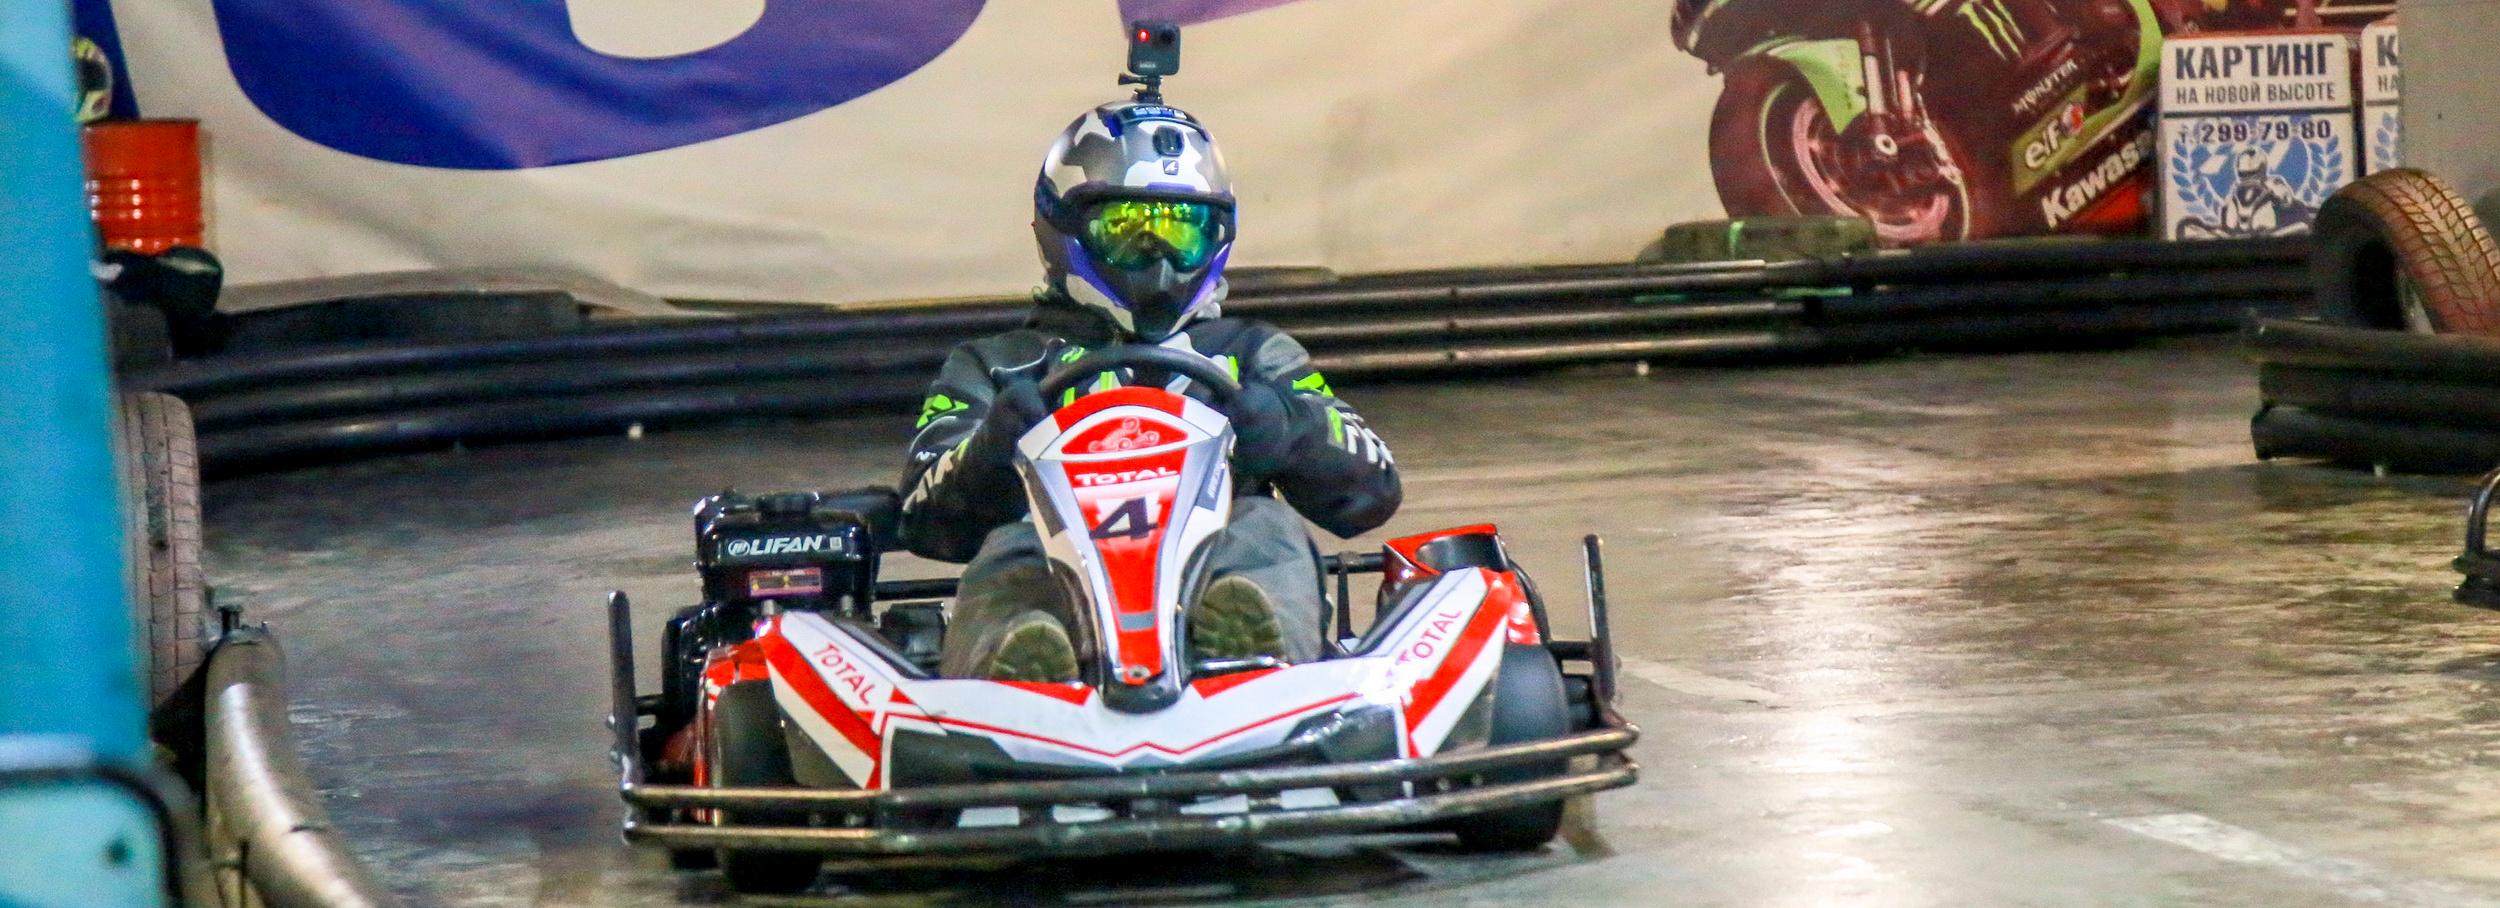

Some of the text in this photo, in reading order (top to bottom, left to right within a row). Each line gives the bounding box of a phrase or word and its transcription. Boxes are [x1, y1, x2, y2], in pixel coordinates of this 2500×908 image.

[2176, 42, 2334, 80] КАРТИНГ
[2176, 82, 2336, 104] НА НОВОЙ ВЫСОТЕ
[1075, 466, 1179, 486] TOTAL
[1089, 496, 1159, 540] 4
[750, 535, 823, 556] LIFAN
[1395, 611, 1462, 666] TOTAL
[813, 643, 876, 705] TOTAL
